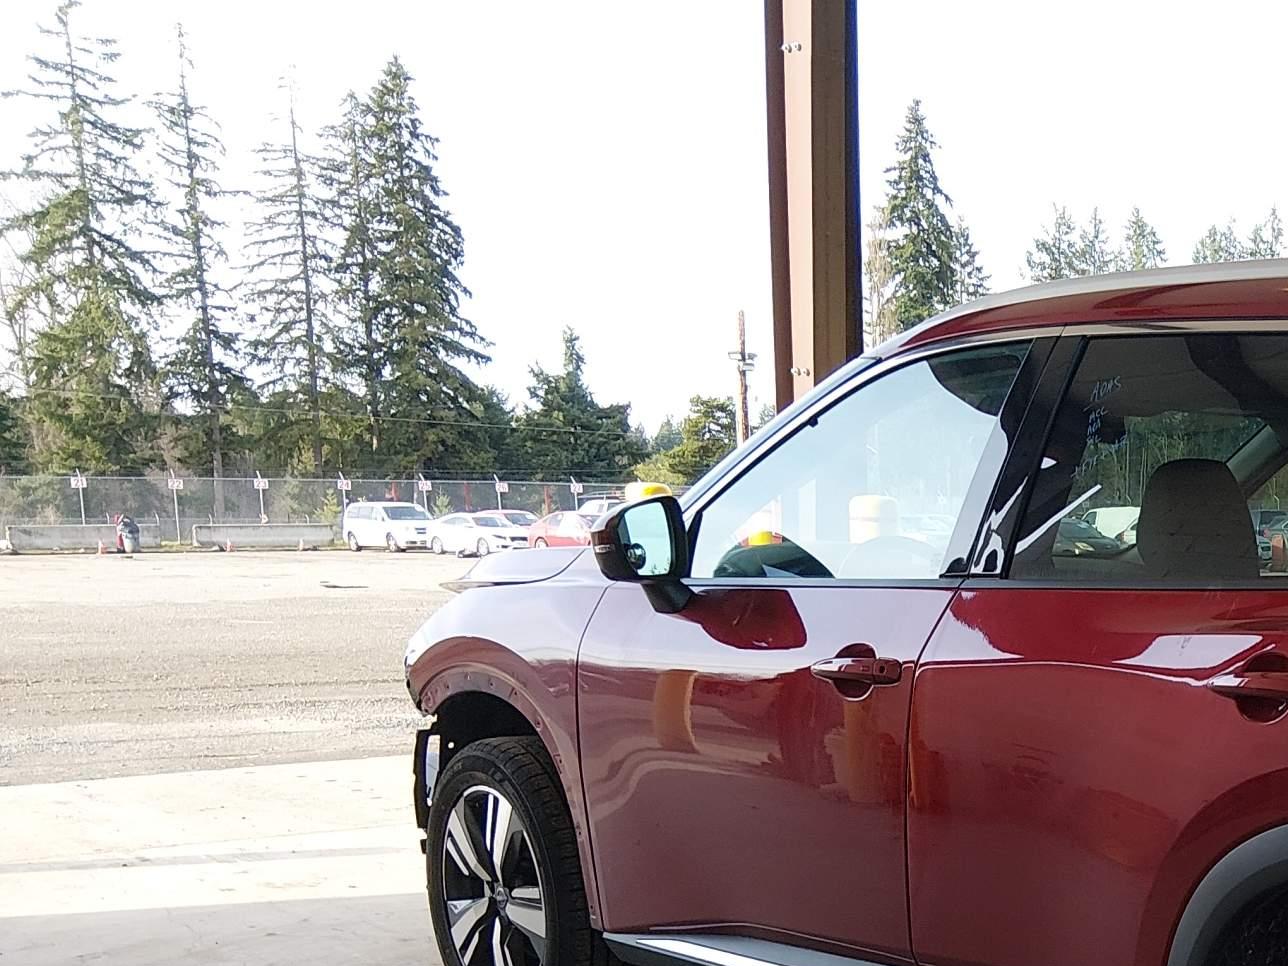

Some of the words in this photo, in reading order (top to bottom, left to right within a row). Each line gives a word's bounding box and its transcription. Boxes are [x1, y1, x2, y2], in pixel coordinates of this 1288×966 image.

[73, 478, 85, 487] 21
[169, 479, 182, 488] 22
[339, 480, 350, 488] 24
